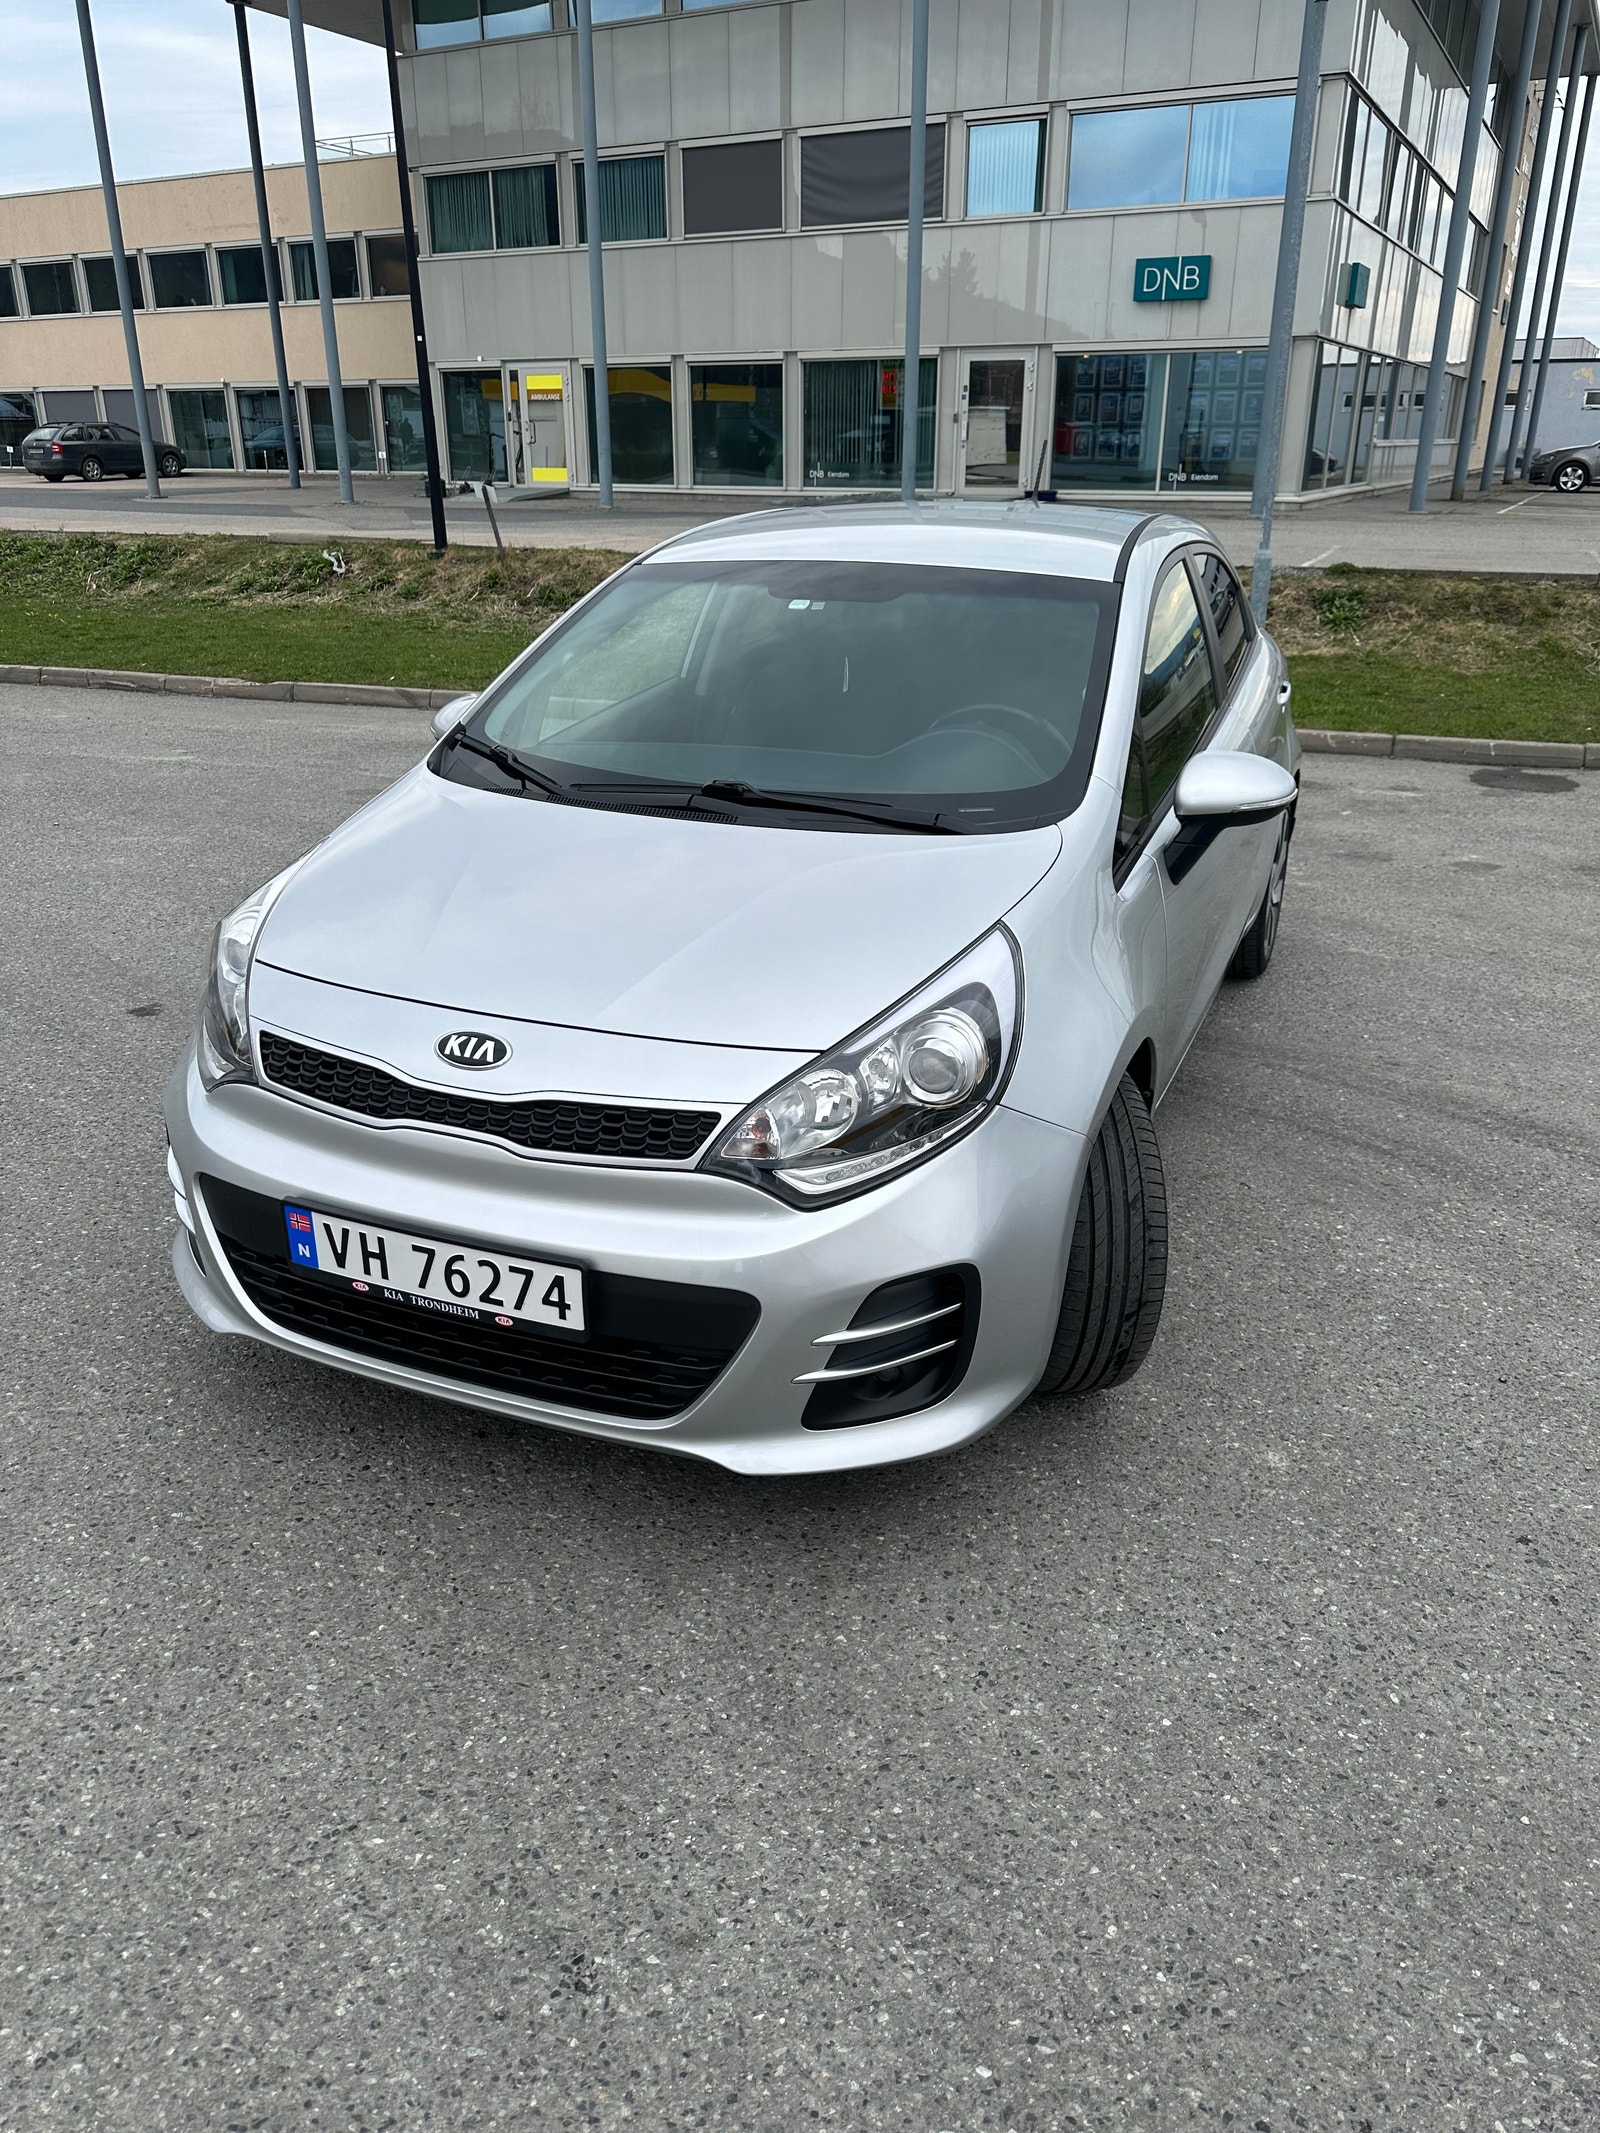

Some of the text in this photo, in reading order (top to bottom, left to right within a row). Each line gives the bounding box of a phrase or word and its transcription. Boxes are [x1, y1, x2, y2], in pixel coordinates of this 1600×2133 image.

[1143, 256, 1200, 301] DNB
[530, 393, 561, 401] AMBULANSE
[809, 461, 825, 486] DNB
[1168, 463, 1219, 491] DNB Eiendom
[444, 1034, 496, 1063] KIA
[298, 1242, 311, 1258] N
[322, 1221, 571, 1321] VH 76274
[384, 1288, 480, 1319] KIA TRONDHEIM
